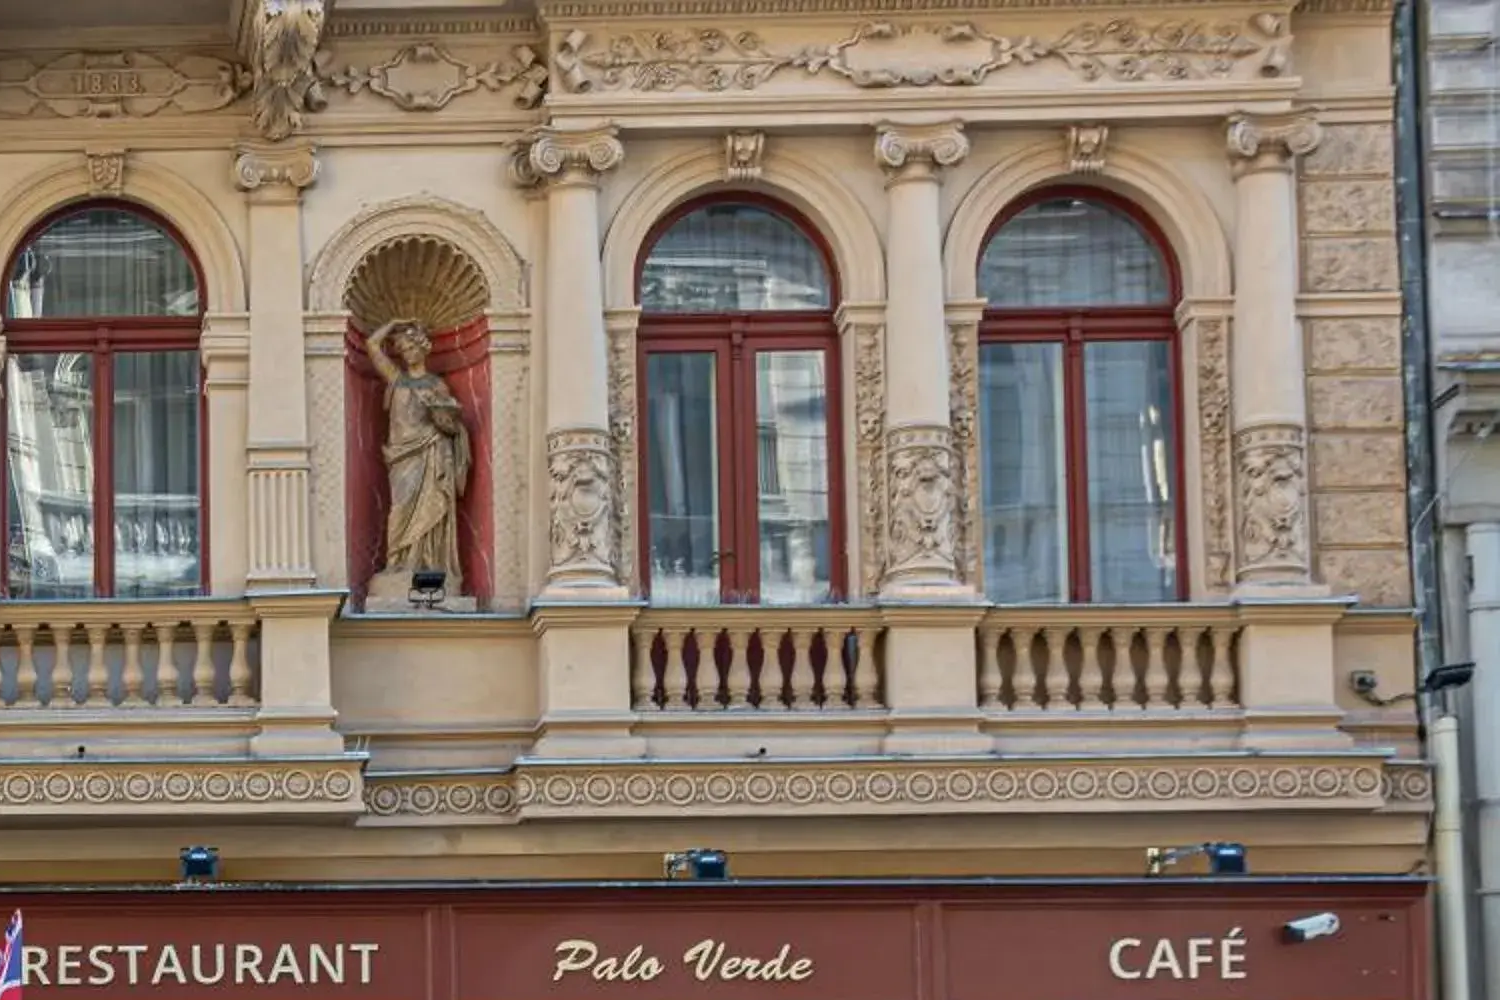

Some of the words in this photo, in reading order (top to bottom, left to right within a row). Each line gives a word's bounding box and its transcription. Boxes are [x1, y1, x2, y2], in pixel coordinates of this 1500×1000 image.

[21, 943, 379, 985] RESTAURANT
[553, 939, 665, 981] Palo
[683, 938, 813, 981] Verde
[1108, 926, 1248, 980] CAFÉ
